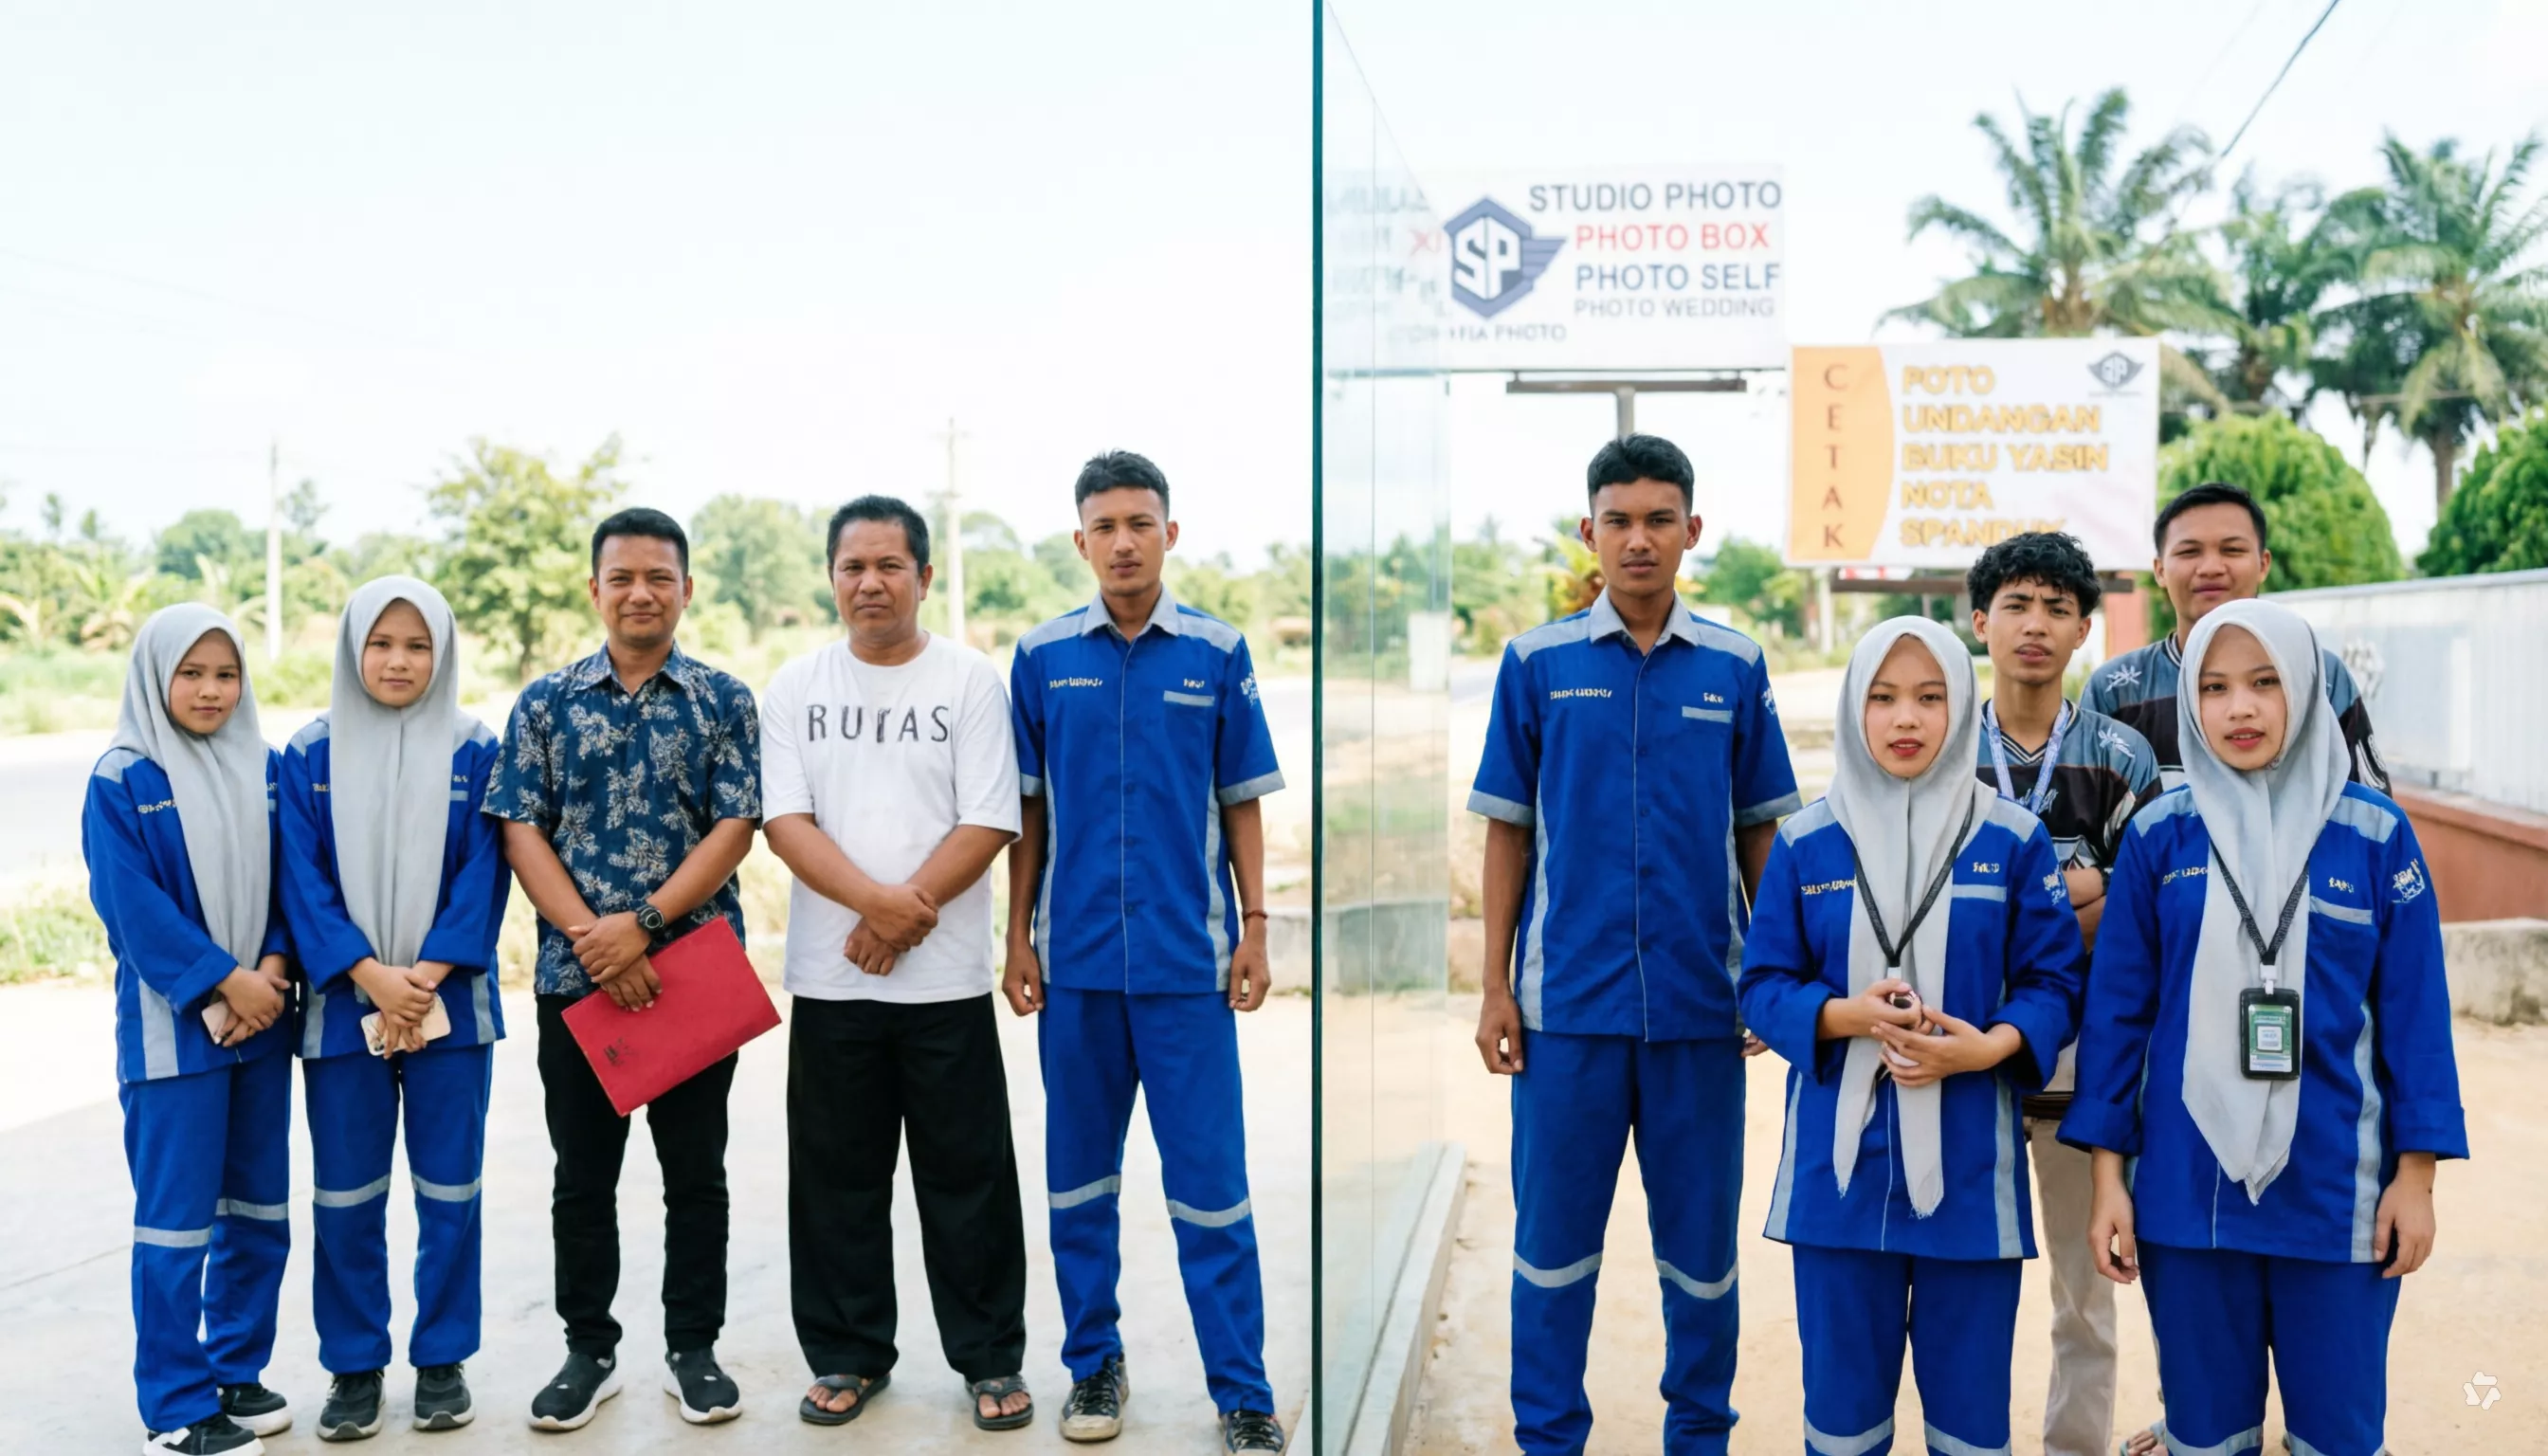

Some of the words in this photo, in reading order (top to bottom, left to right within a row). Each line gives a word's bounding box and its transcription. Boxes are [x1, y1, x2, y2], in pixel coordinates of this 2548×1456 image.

[1529, 183, 1653, 213] STUDIO
[1665, 180, 1782, 211] PHOTO
[1575, 224, 1689, 252] PHOTO
[1702, 223, 1770, 251] BOX
[1454, 215, 1521, 300] SP
[1575, 264, 1689, 291] PHOTO
[1702, 263, 1781, 291] SELF
[1574, 299, 1656, 318] PHOTO
[1665, 298, 1775, 318] WEDDING
[1495, 323, 1568, 342] PHOTO
[1902, 365, 1996, 396] POTO
[1902, 404, 2102, 435] UNDANGAN
[1822, 364, 1847, 550] CETAK
[1902, 443, 1998, 473] BUKU
[2007, 443, 2110, 473] YASIN
[1902, 481, 1994, 512] NOTA
